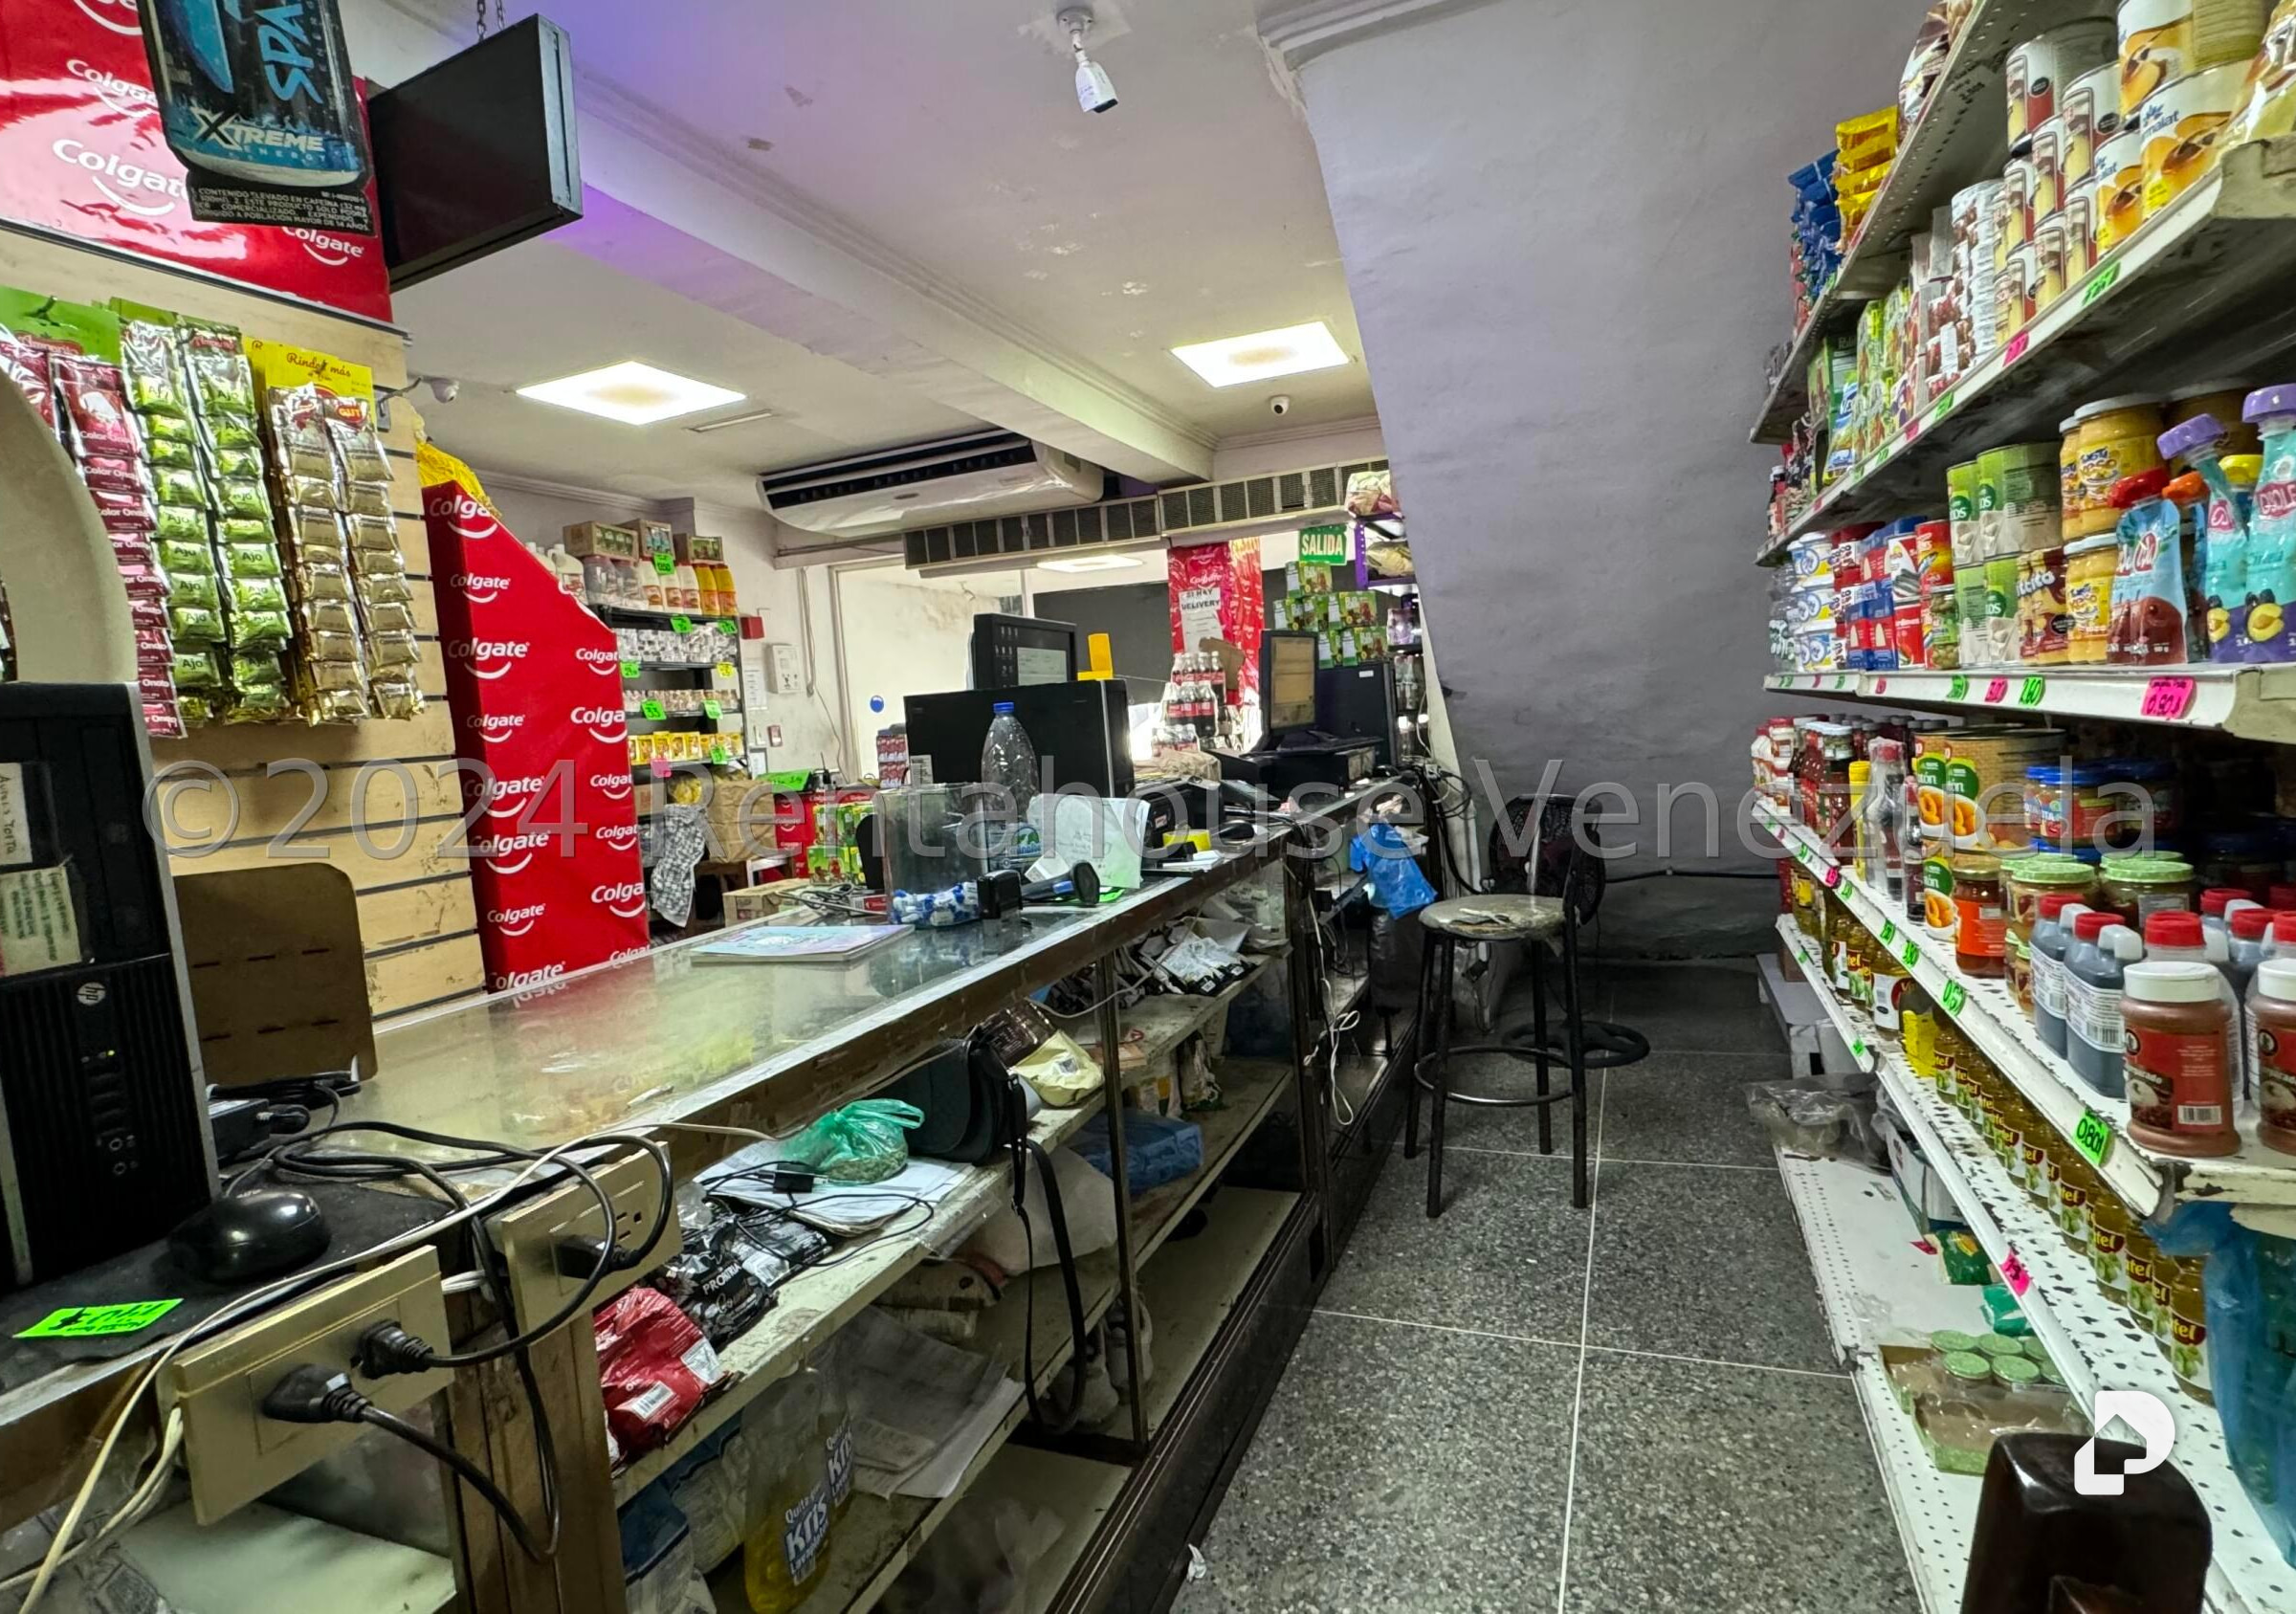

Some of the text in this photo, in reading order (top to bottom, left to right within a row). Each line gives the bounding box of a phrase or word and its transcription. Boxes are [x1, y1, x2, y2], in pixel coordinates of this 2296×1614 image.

[190, 106, 326, 153] XTREME
[1301, 533, 1343, 556] SALIDA
[241, 550, 264, 562] Ajo
[179, 579, 202, 592] Ajo
[449, 572, 511, 590] Colgate
[185, 611, 208, 624] Ajo
[447, 637, 529, 661] Colgate
[182, 657, 204, 670] Ajo
[466, 713, 524, 731] Colgate
[463, 775, 543, 801] Colgate
[472, 831, 549, 857] Colgate
[486, 904, 545, 924] Colgate
